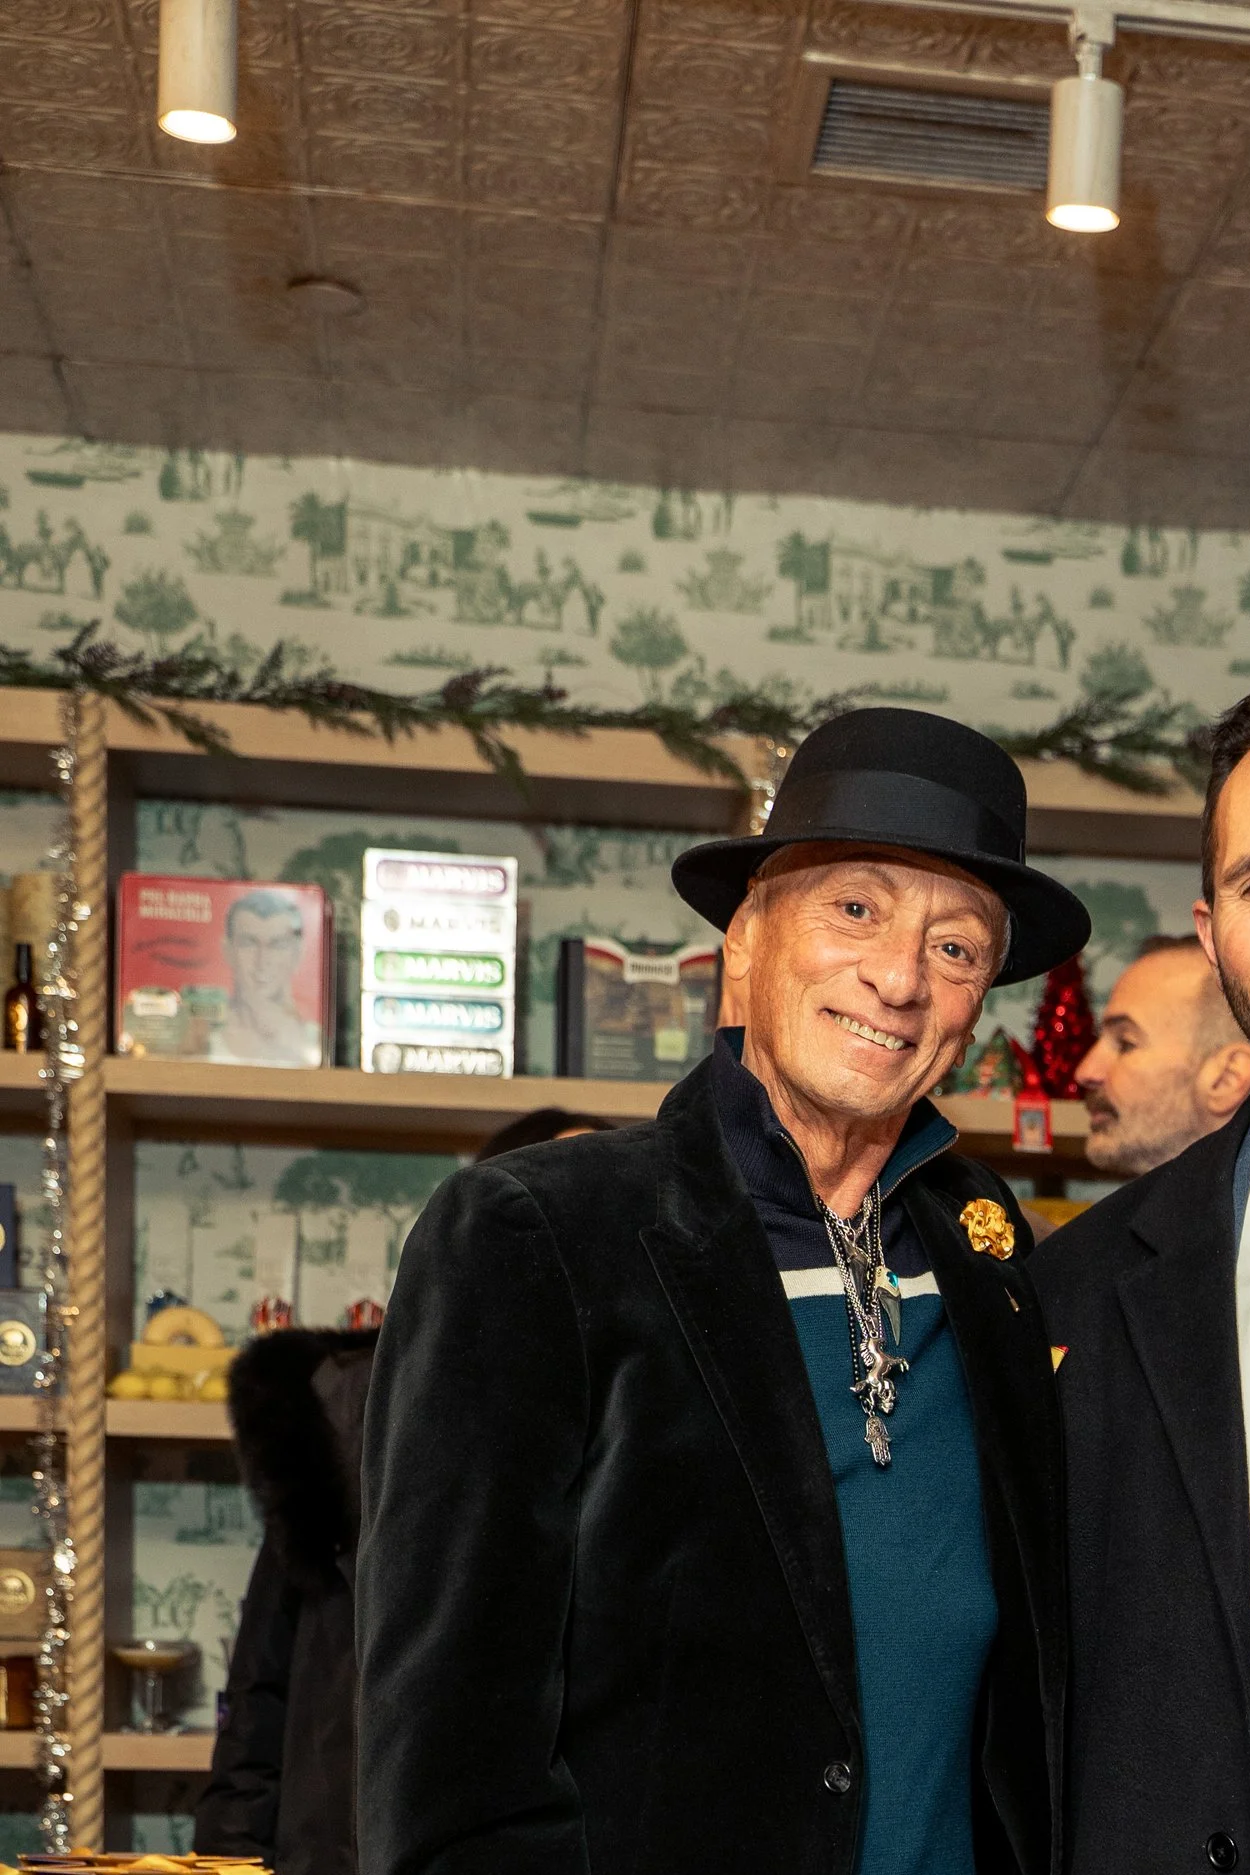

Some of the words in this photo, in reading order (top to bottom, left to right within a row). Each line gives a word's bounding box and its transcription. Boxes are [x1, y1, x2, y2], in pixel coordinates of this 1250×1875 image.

[405, 864, 506, 893] MARVIS
[403, 956, 503, 984] MARVIS
[402, 1002, 502, 1029] MARVIS
[404, 1046, 503, 1076] MARVIS
